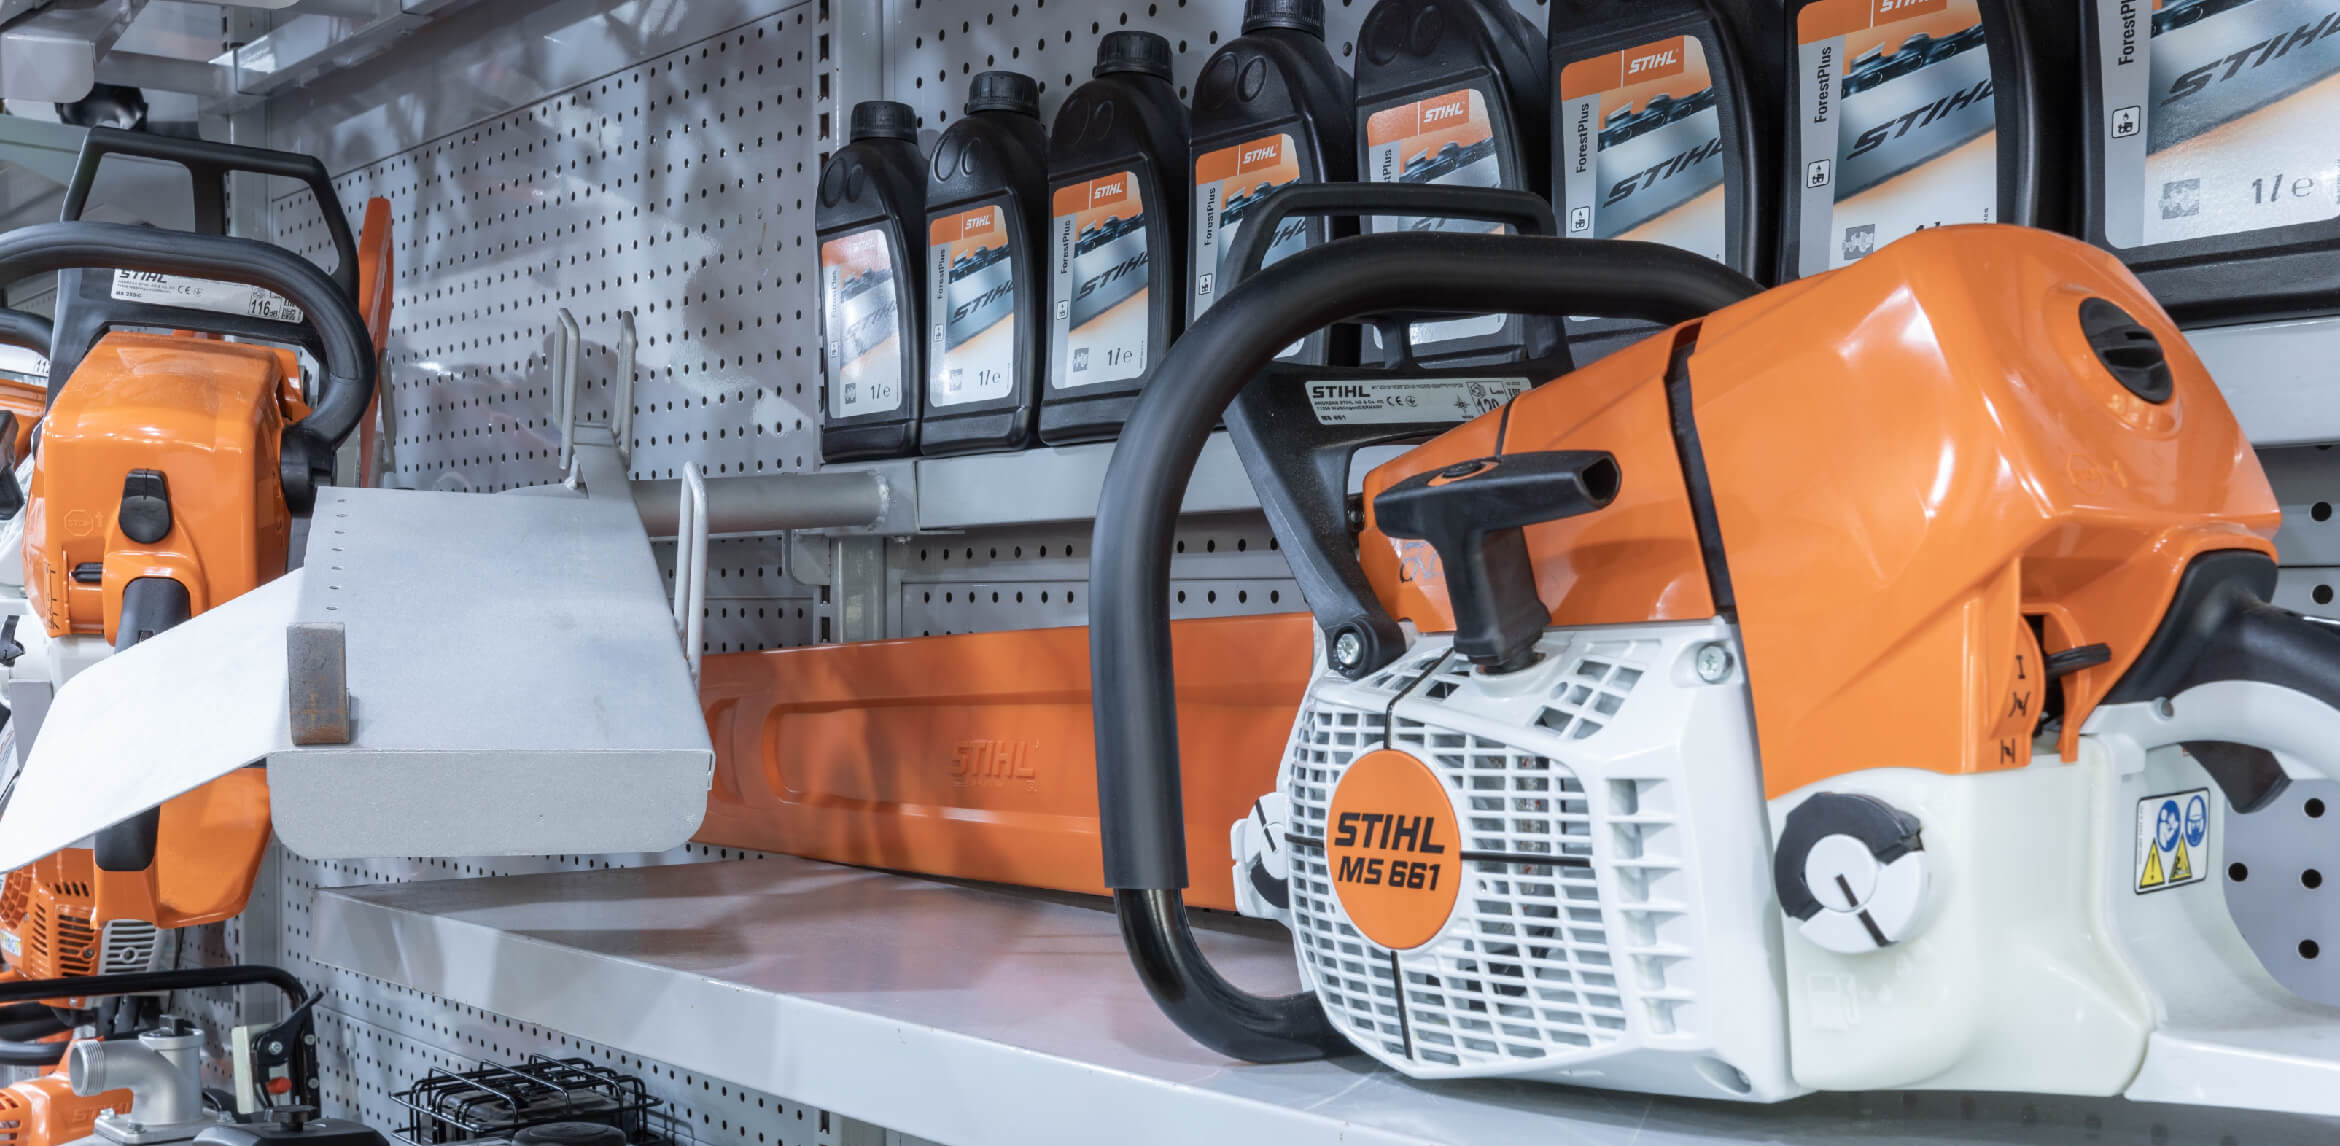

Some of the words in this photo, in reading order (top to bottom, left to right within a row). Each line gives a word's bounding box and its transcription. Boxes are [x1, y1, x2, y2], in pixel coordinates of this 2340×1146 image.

[1628, 50, 1677, 74] STIHL
[1814, 46, 1832, 124] ForestPlus
[1424, 102, 1464, 123] STIHL
[1576, 103, 1589, 174] ForestPlus
[1243, 147, 1277, 164] STIHL
[1094, 183, 1123, 199] STIHL
[965, 216, 991, 230] STIHL
[1204, 187, 1216, 246] ForestPlus
[1061, 220, 1071, 274] ForestPlus
[251, 299, 270, 316] 116
[1312, 386, 1371, 399] STIHL
[952, 739, 1035, 780] STIHL
[1334, 812, 1445, 854] STIHL
[1338, 856, 1384, 885] MS
[1388, 860, 1441, 891] 661
